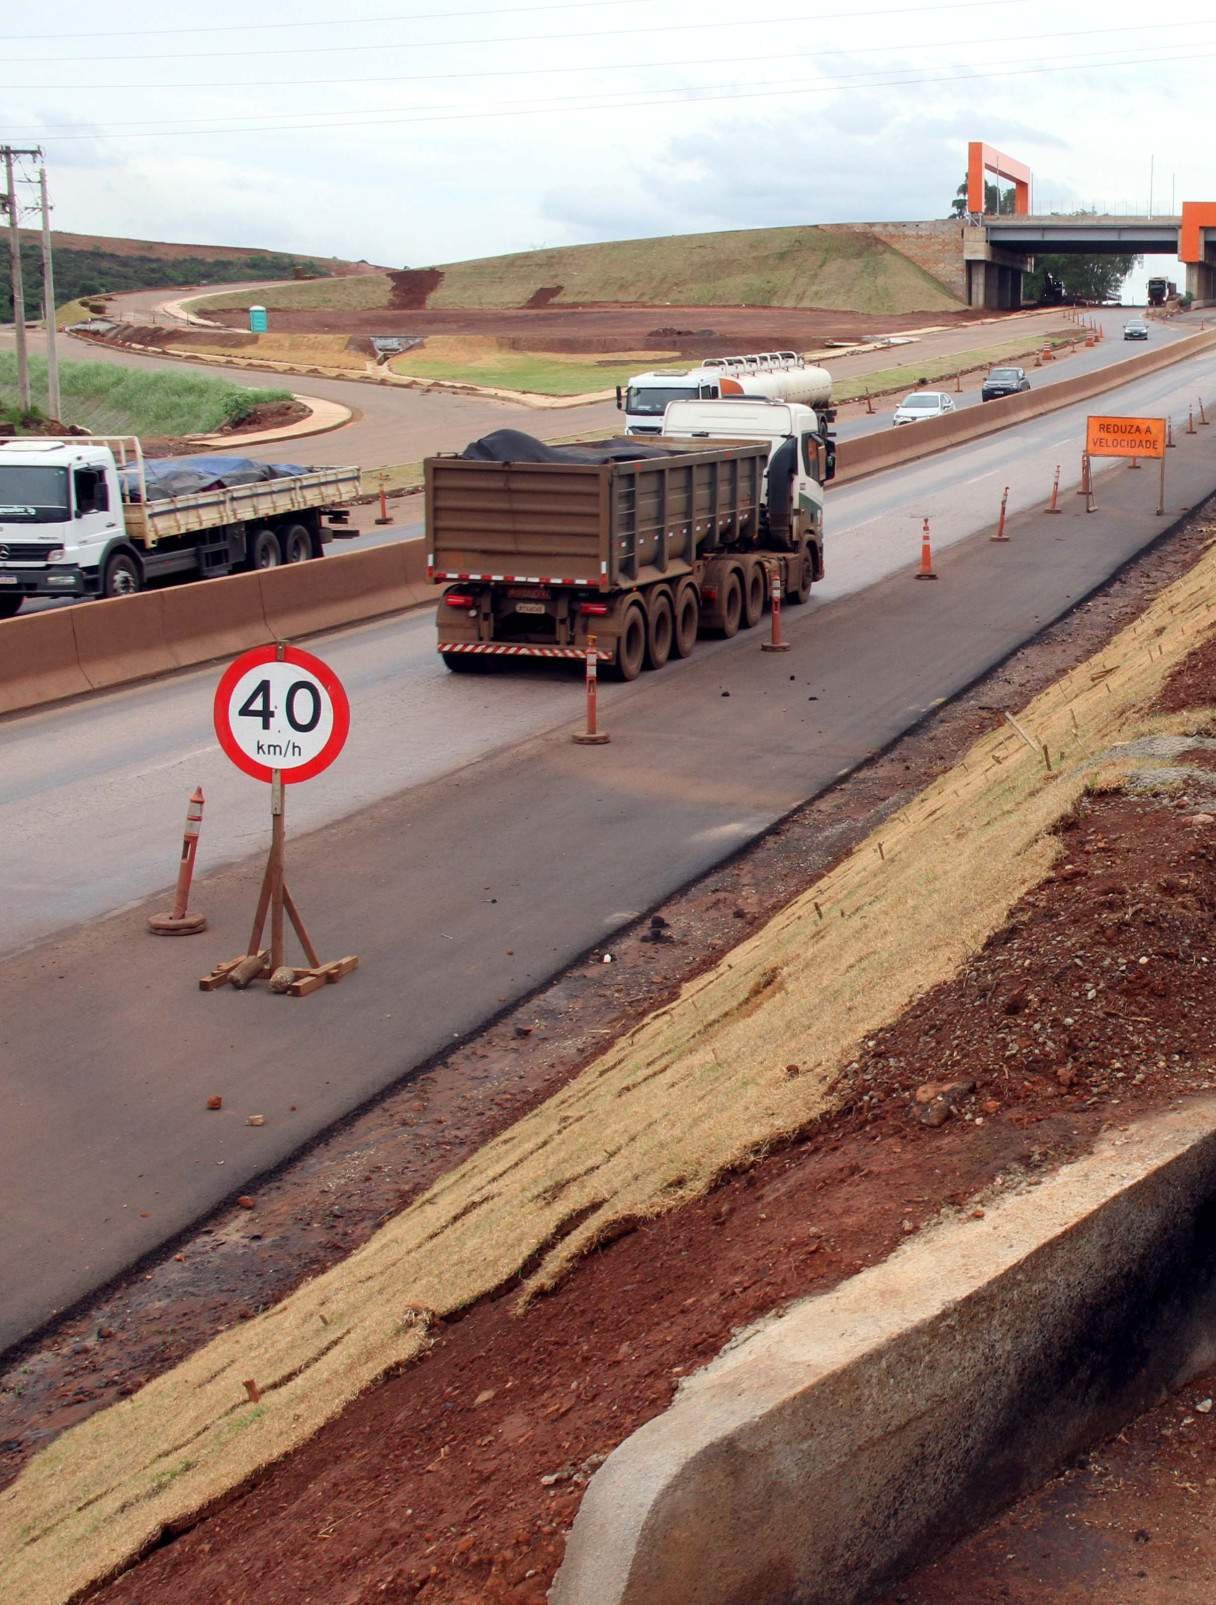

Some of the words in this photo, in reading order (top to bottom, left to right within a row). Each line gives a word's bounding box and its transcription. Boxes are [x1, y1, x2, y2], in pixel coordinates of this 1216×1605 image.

[1099, 423, 1141, 435] REDUZA
[1144, 425, 1152, 435] A
[1092, 438, 1158, 450] VELOCIDADE
[238, 679, 322, 733] 40
[256, 740, 302, 758] km/h
